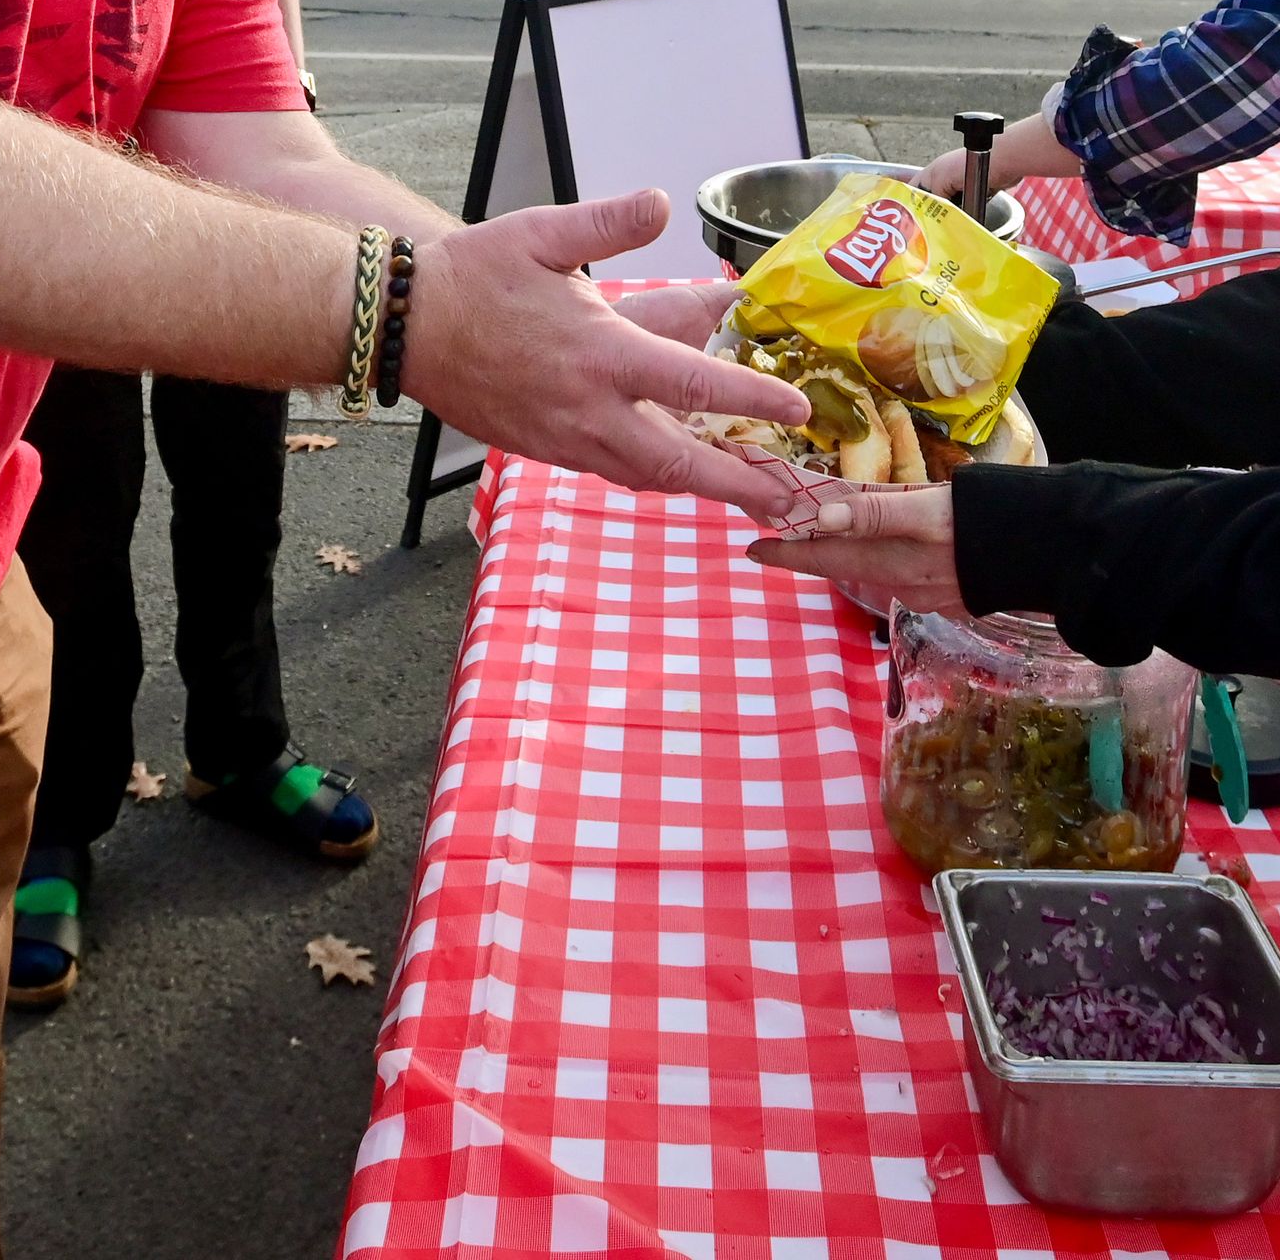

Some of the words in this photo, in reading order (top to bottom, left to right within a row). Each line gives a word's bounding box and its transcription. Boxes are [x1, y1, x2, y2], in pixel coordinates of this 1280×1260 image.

[828, 201, 908, 283] Lay's
[920, 259, 961, 307] Classic
[989, 381, 1008, 407] CHIPS
